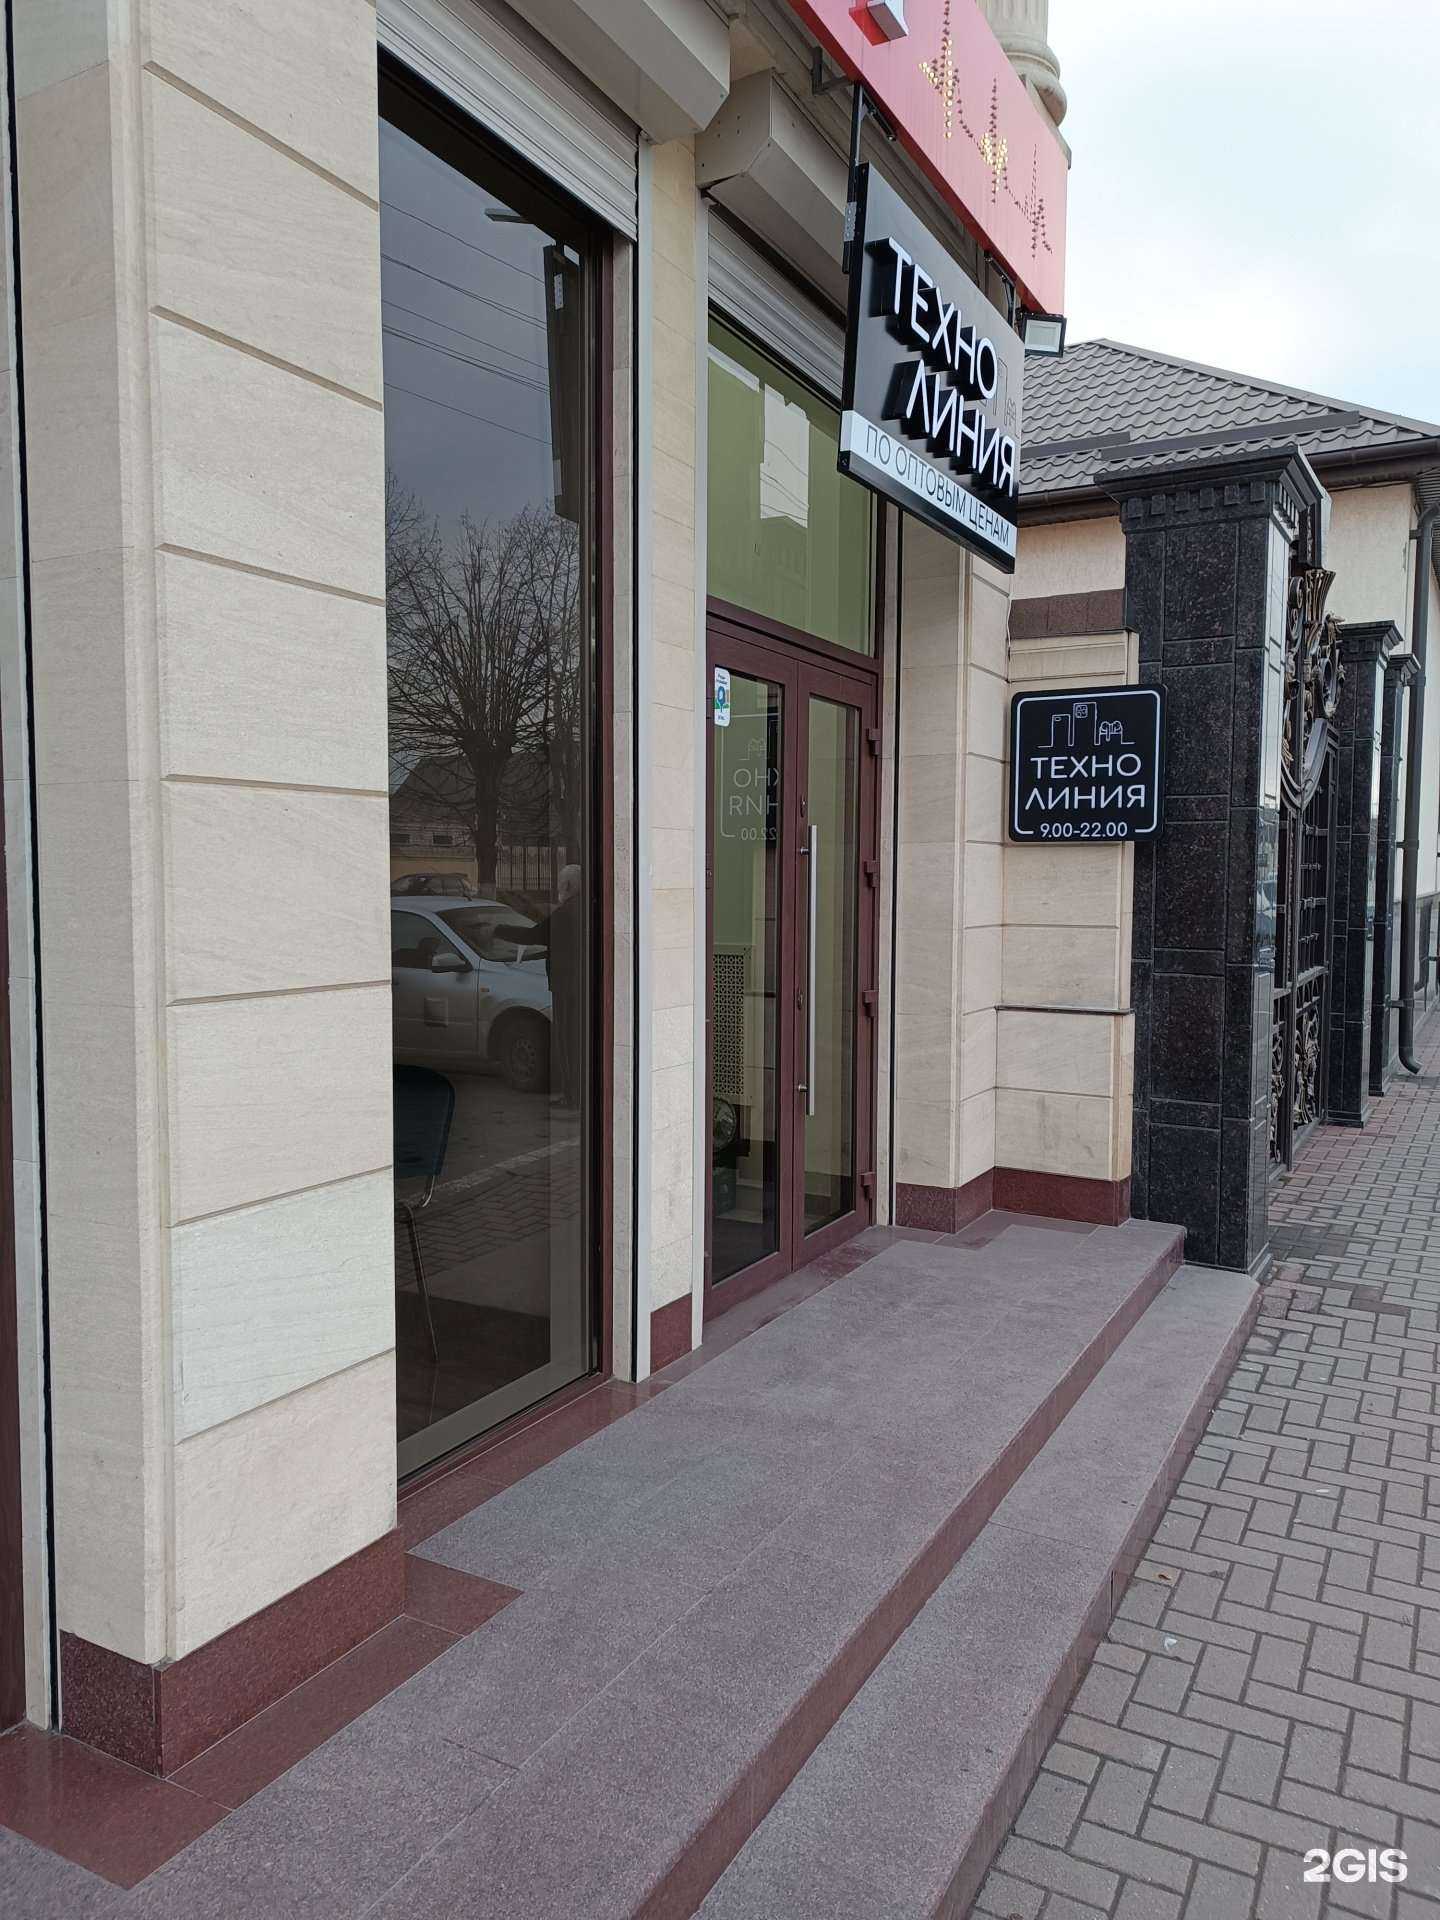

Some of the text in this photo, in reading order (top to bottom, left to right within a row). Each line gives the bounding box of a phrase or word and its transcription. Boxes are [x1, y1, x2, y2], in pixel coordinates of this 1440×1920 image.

[888, 236, 998, 400] ТЕХНО
[906, 358, 1016, 498] ЛИНИЯ
[866, 424, 1010, 546] ПО ОПТОВЫМ ЦЕНАМ
[1025, 784, 1146, 810] ЛИНИЯ
[1030, 753, 1142, 779] ТЕХНО
[1040, 822, 1128, 838] 9.00-22.00
